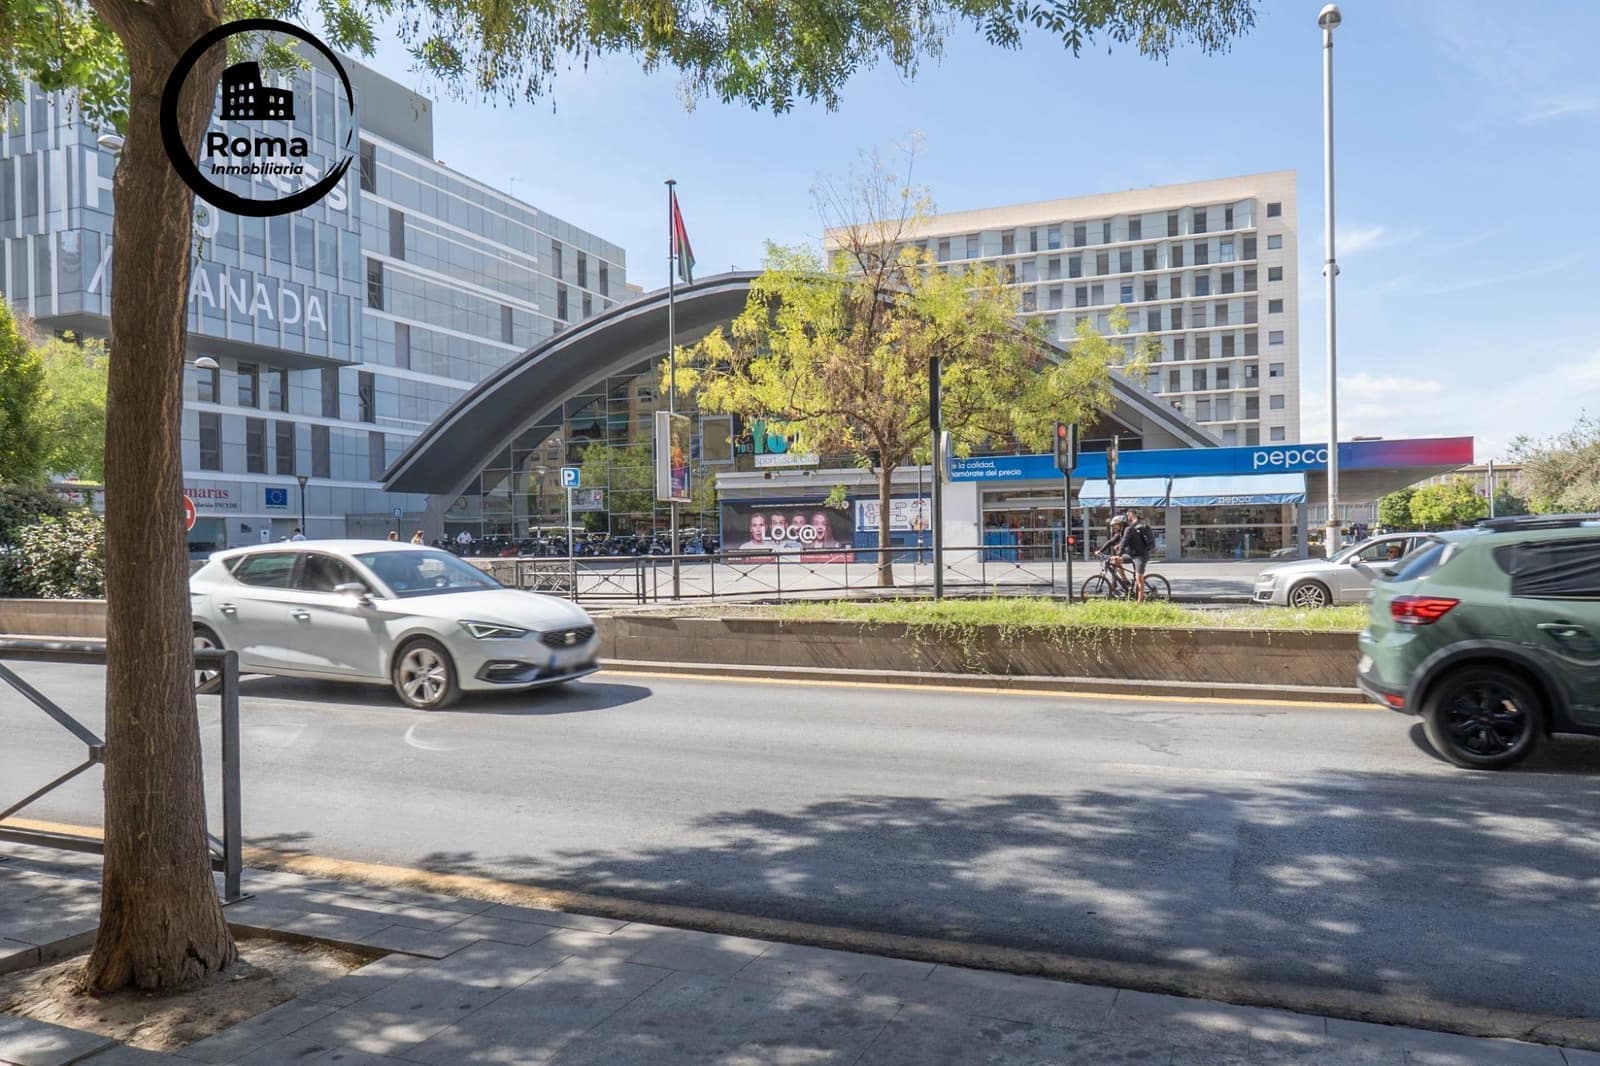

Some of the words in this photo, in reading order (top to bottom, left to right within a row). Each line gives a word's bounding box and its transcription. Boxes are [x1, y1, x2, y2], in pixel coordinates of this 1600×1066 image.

[958, 461, 966, 469] la
[966, 460, 996, 469] calidad,
[1253, 448, 1329, 469] pepco
[563, 470, 575, 486] P
[985, 469, 998, 477] del
[998, 467, 1022, 477] precio
[183, 487, 230, 499] maras
[761, 524, 817, 544] LOC@
